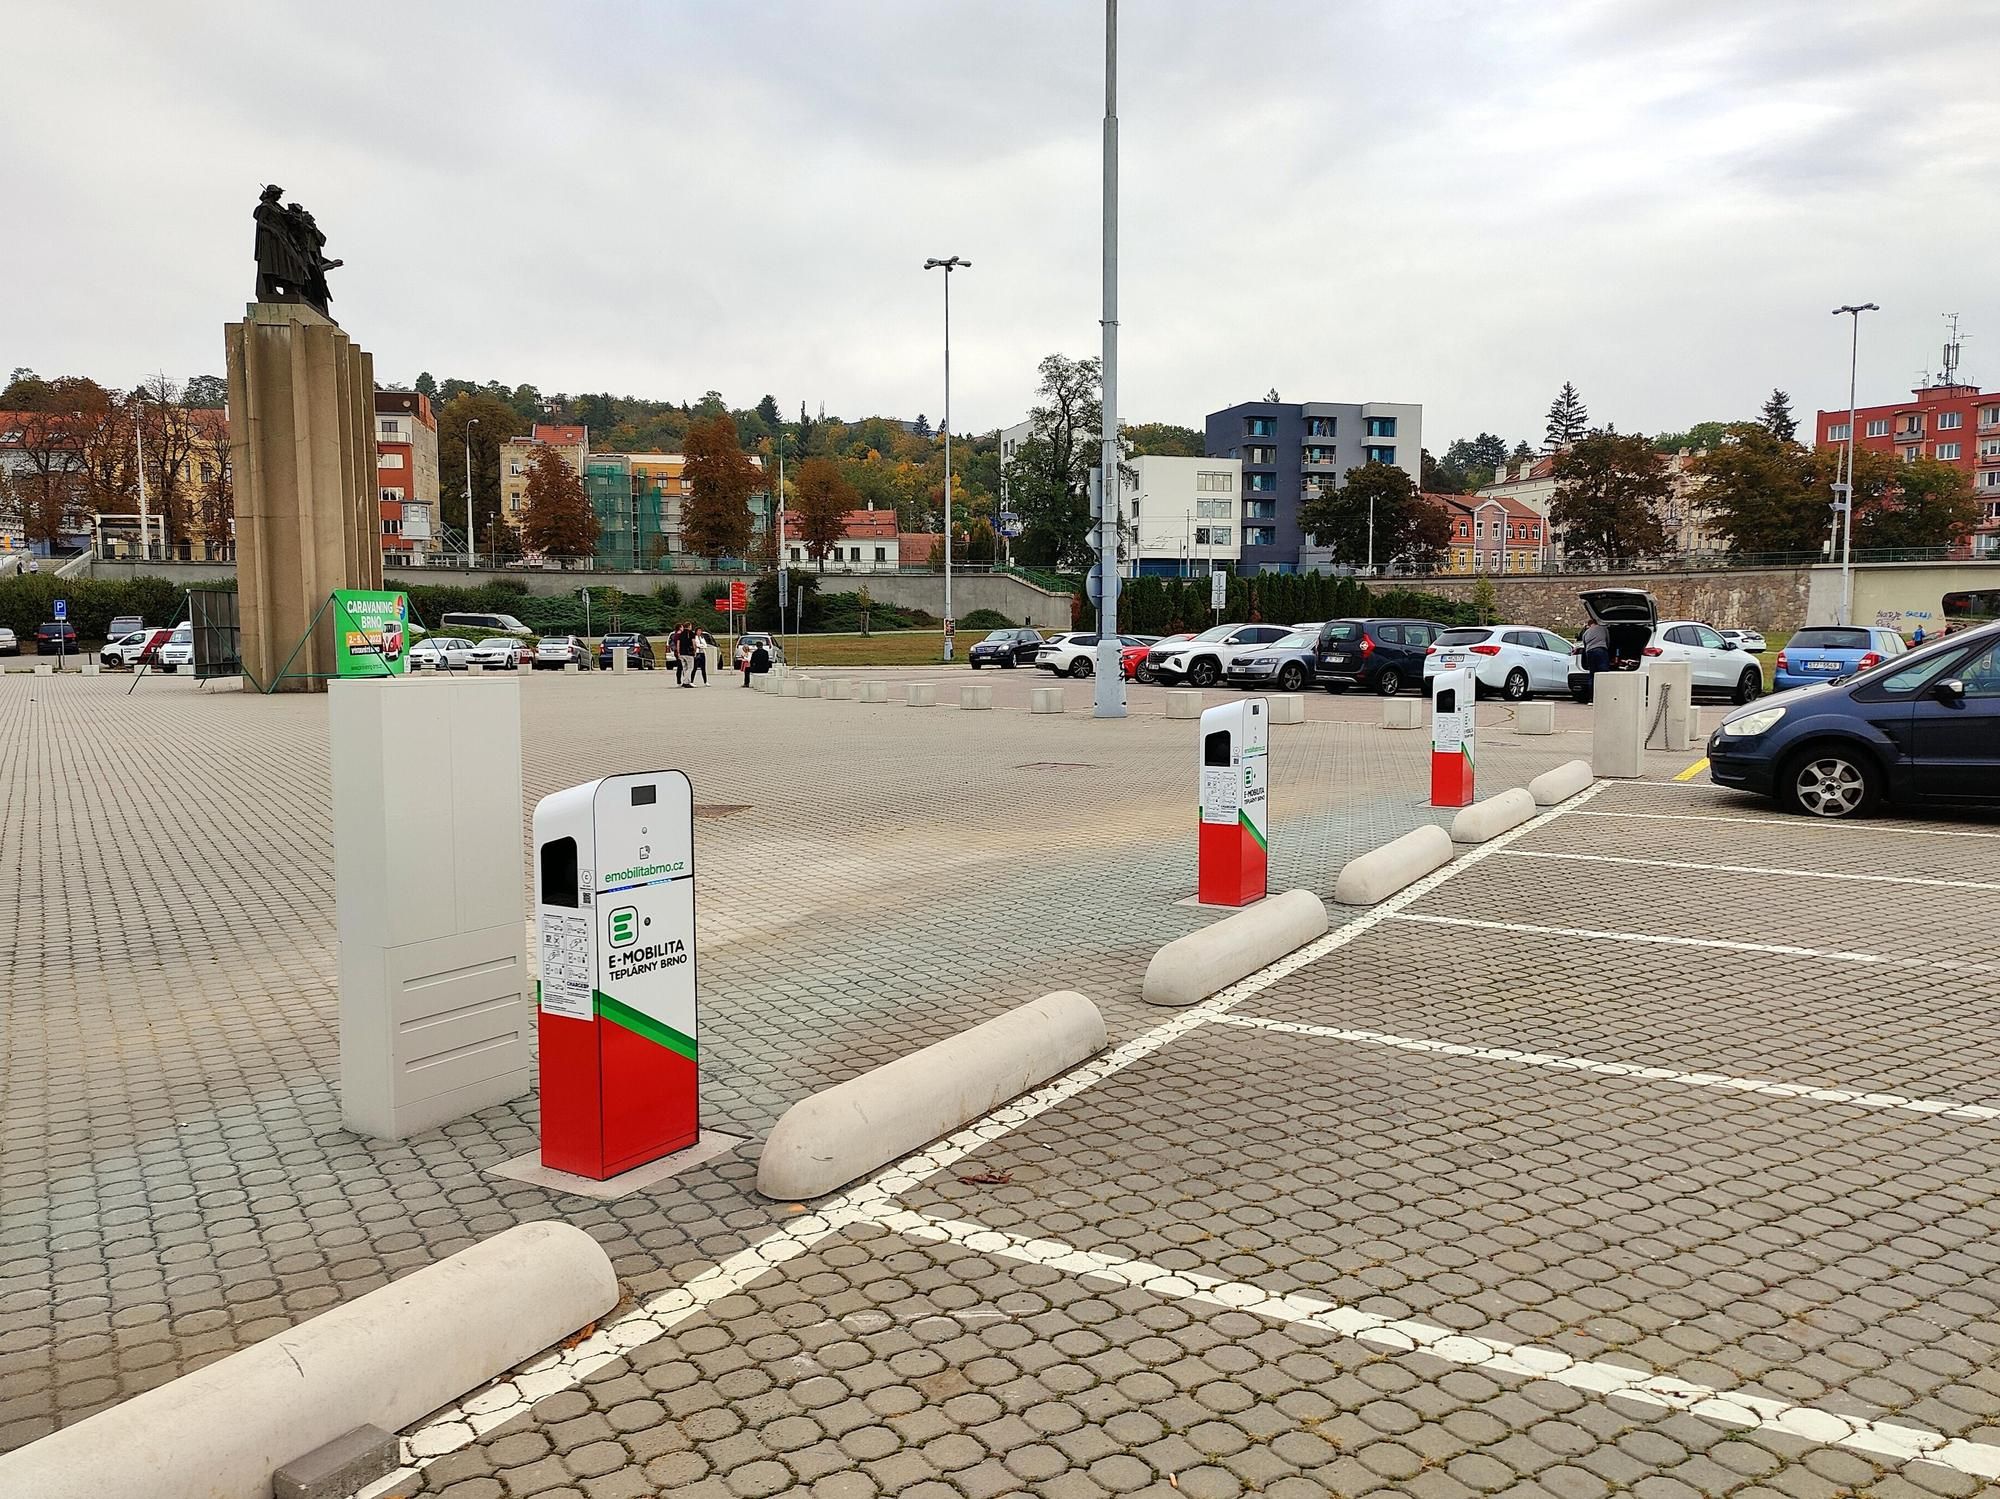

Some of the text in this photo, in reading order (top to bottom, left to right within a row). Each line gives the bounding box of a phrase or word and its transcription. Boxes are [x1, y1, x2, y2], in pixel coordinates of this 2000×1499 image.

[56, 601, 64, 612] P
[347, 601, 392, 613] CARAVANING
[361, 616, 382, 628] BRNO
[605, 861, 684, 883] emobilitabrno.cz
[608, 939, 685, 969] E-MOBILITA
[608, 954, 688, 981] TEPLÁRNY BRNO
